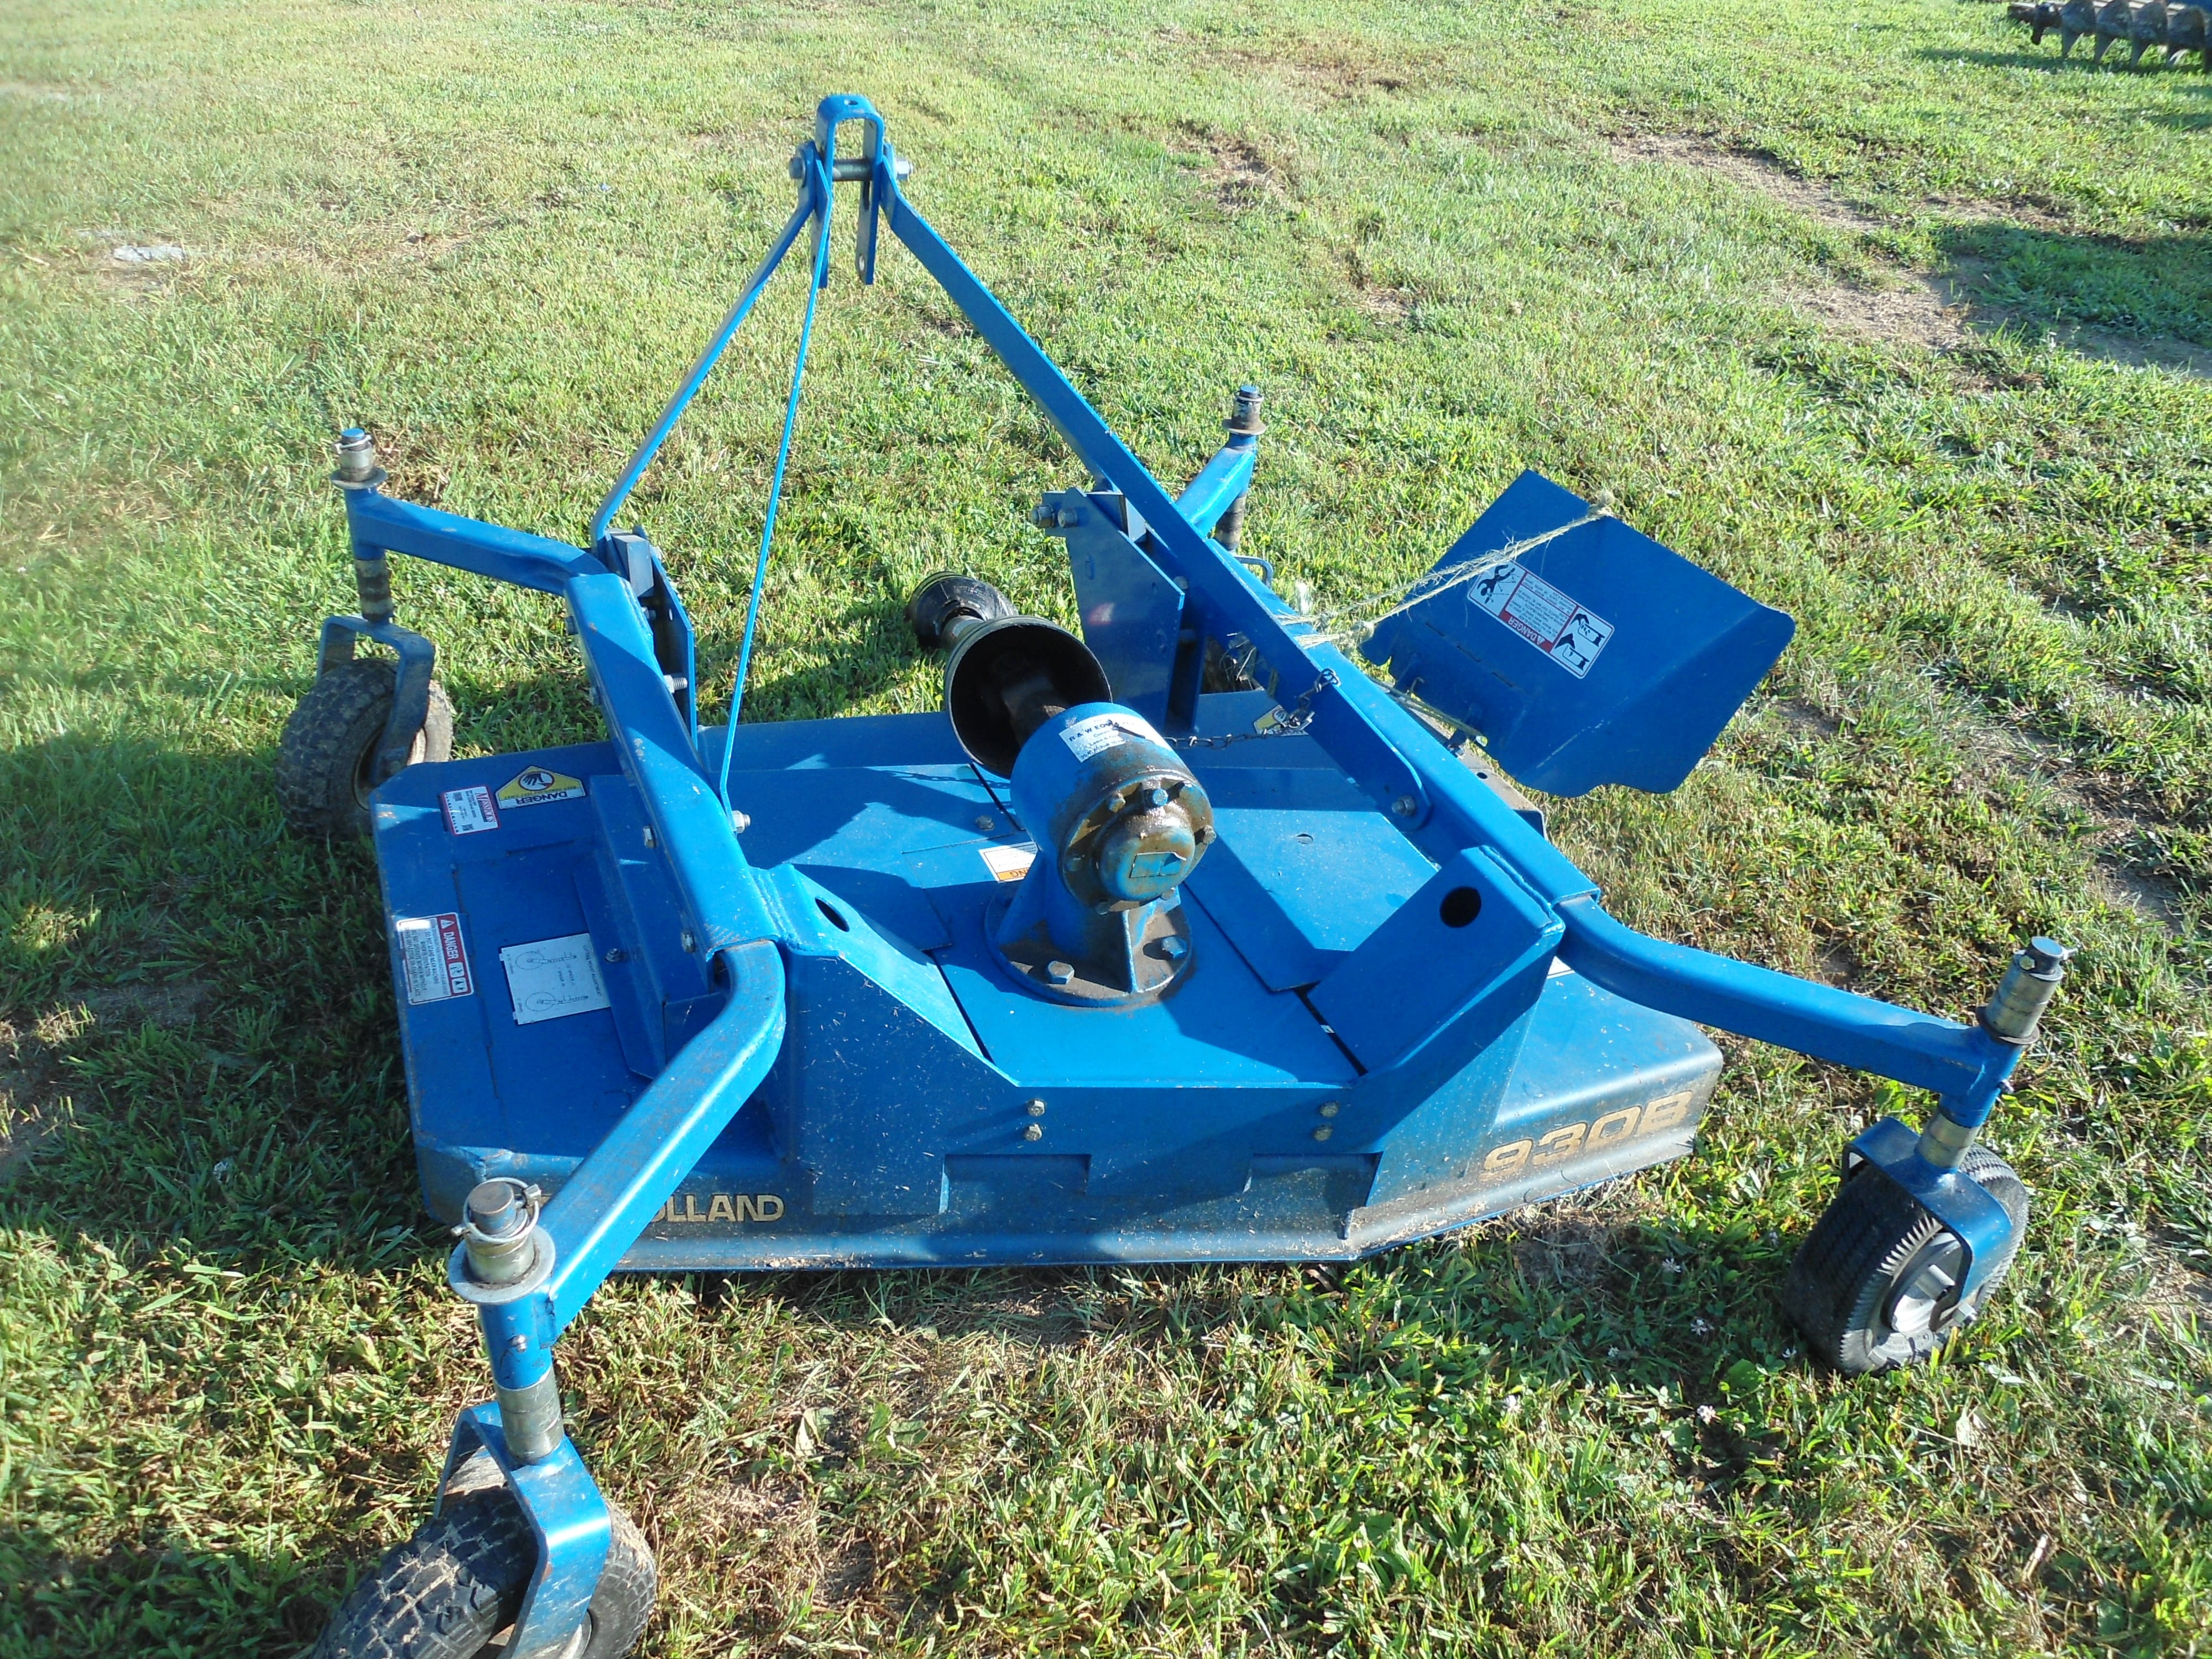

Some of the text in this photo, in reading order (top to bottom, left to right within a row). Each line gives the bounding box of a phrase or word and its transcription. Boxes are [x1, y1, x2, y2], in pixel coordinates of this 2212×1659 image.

[1506, 615, 1538, 641] DANGER
[515, 791, 567, 804] DANGER
[442, 931, 459, 959] DANGER
[1478, 1091, 1693, 1182] 930B
